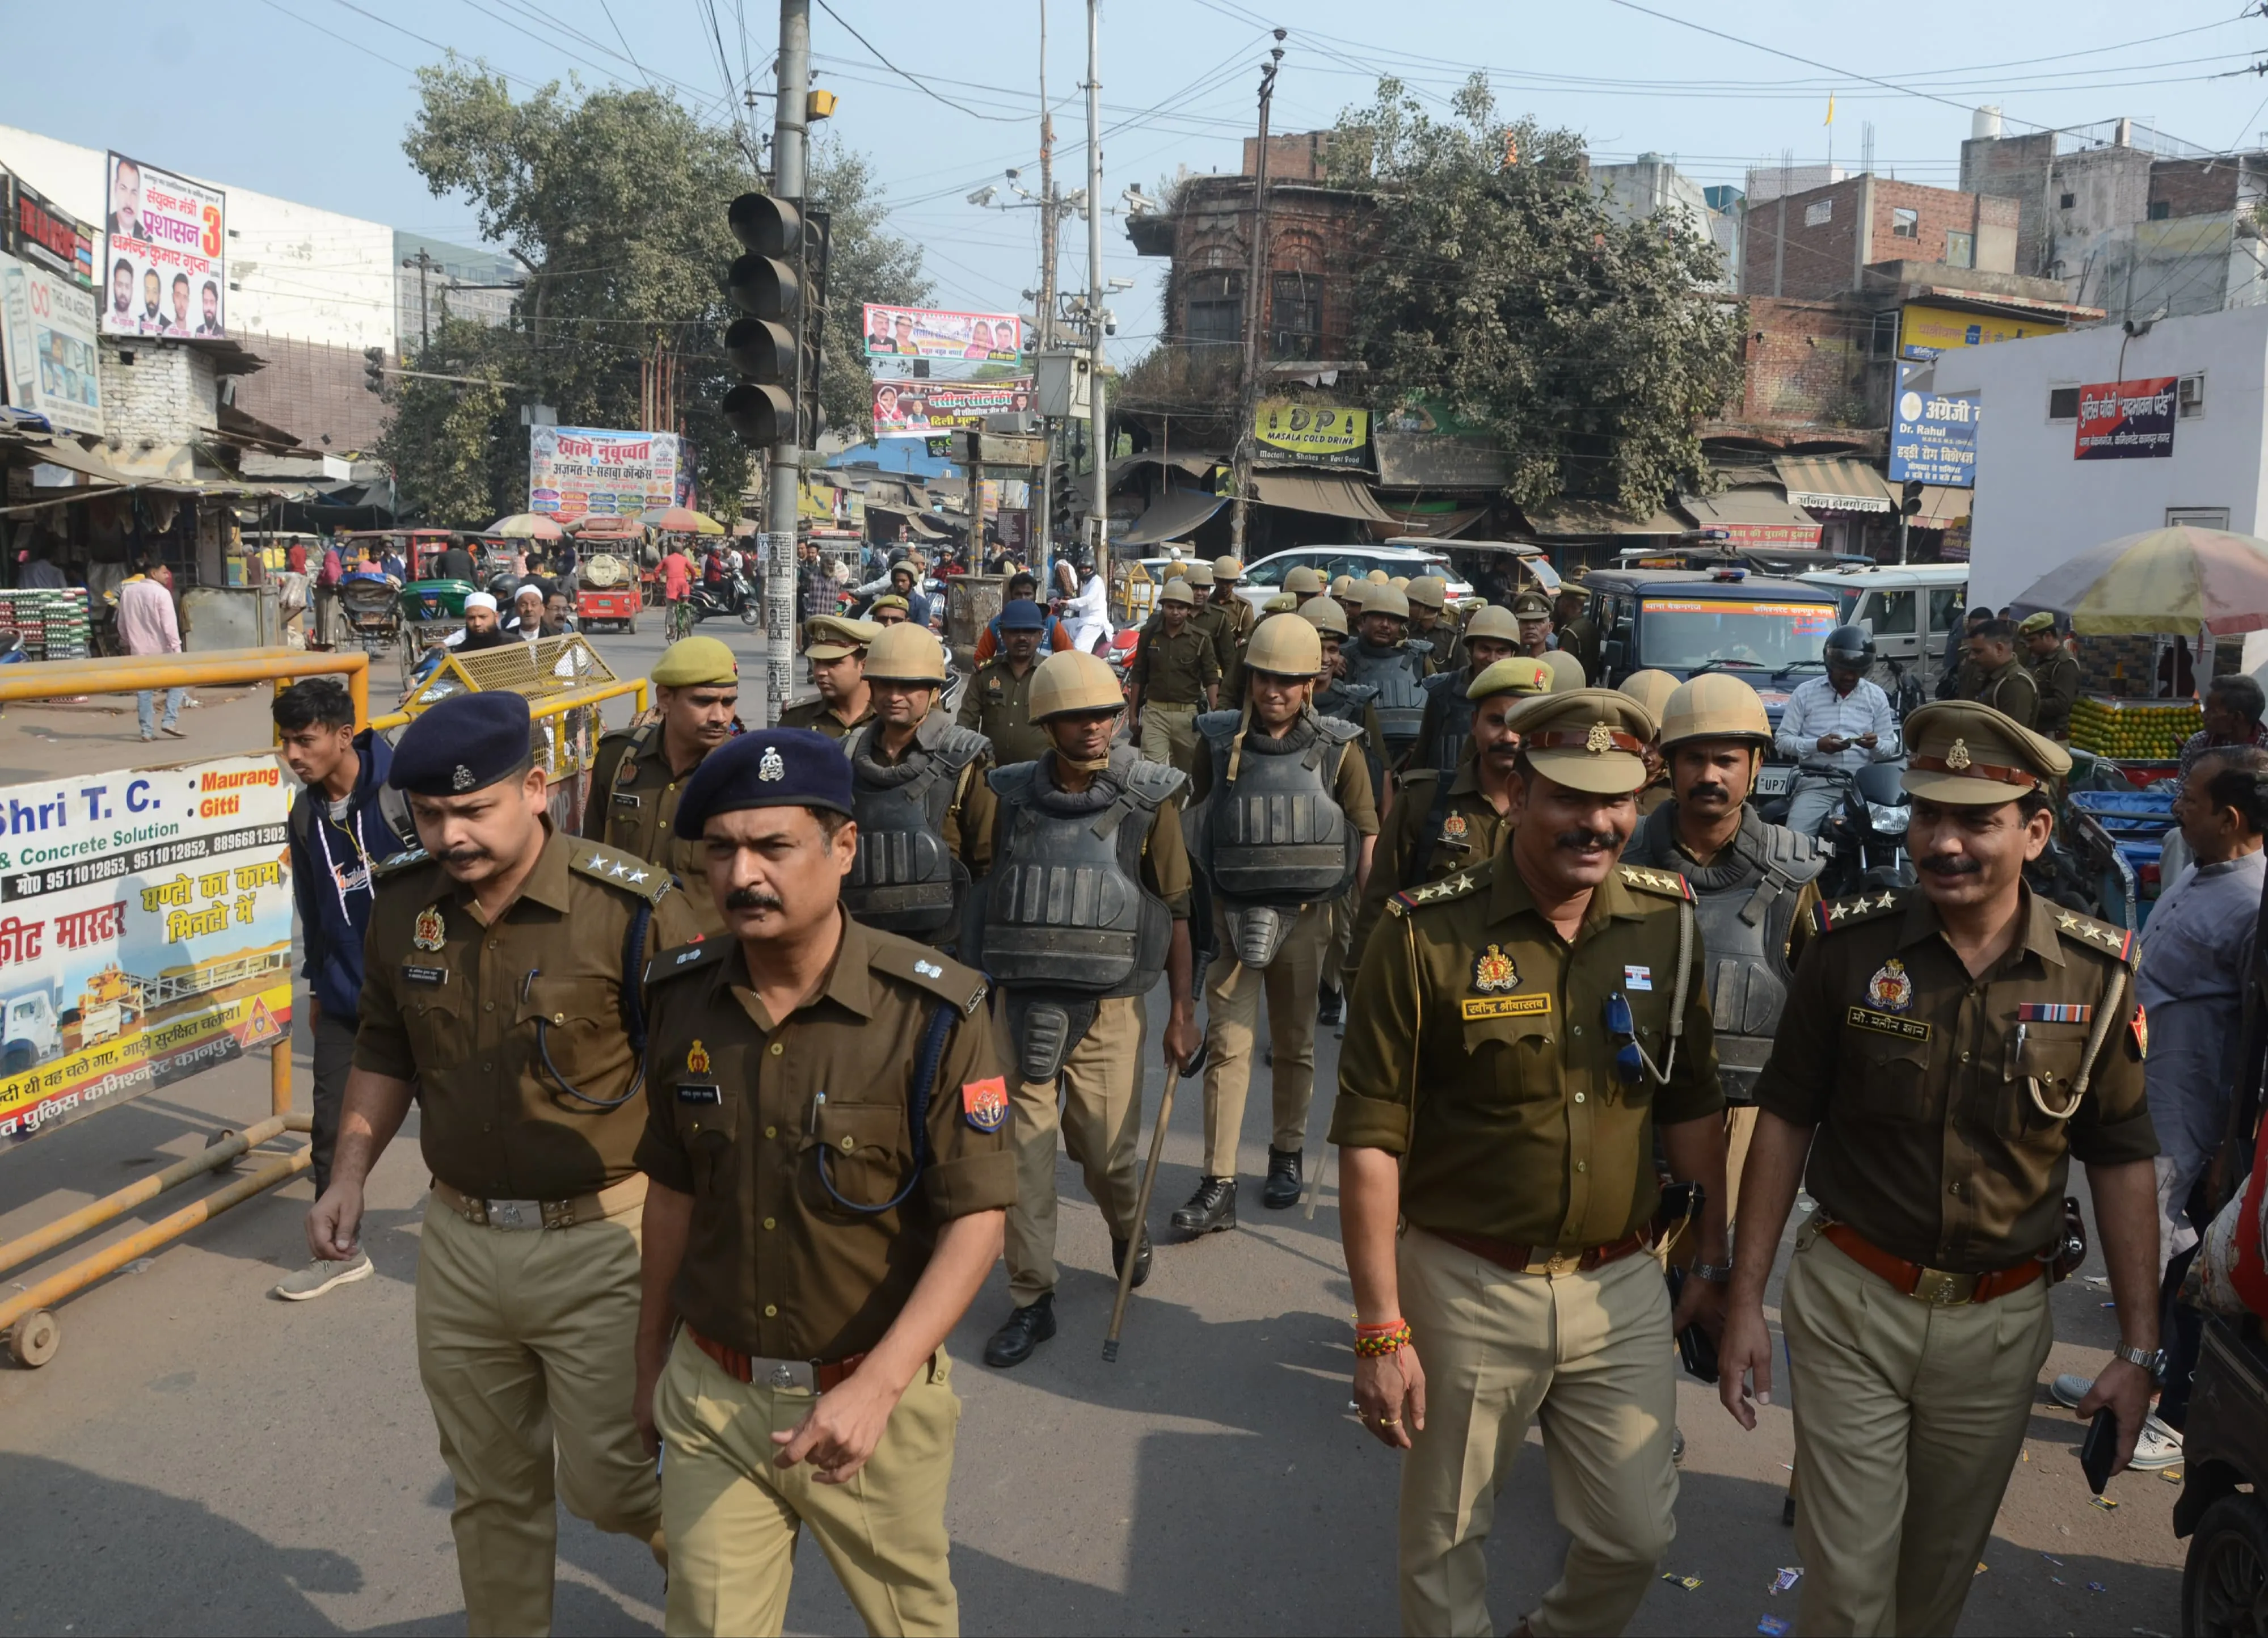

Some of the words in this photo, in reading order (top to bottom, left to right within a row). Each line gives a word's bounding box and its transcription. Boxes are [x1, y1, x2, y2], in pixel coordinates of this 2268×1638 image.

[147, 188, 176, 211] संयुक्त
[179, 195, 197, 217] मंत्री
[143, 209, 200, 247] प्रशासन
[203, 205, 221, 258] 3
[149, 243, 181, 267] कुमार
[184, 253, 209, 276] गुप्ता
[928, 391, 966, 408] नसीम
[968, 390, 1013, 406] सोलंकी
[1926, 397, 1970, 423] अंग्रेजी
[2080, 393, 2099, 428] पुलिस
[2100, 391, 2116, 418] चौकी
[1290, 408, 1335, 433] DP
[1900, 424, 1913, 433] Dr.
[1917, 424, 1946, 437] Rahul
[1267, 432, 1301, 441] MASALA
[1327, 437, 1355, 445] DRINK
[1296, 453, 1318, 461] Shakes
[1921, 445, 1938, 461] रोग
[1750, 528, 1761, 537] की
[1765, 528, 1788, 539] पुरानी
[1791, 530, 1815, 540] दुकान
[1753, 604, 1788, 614] कमिश्नरेट
[1790, 607, 1815, 617] कानपुर
[201, 768, 279, 792] Maurang
[81, 785, 112, 821] T.
[126, 780, 161, 812] C.
[200, 795, 240, 819] Gitti
[20, 836, 107, 866] Concrete
[113, 822, 179, 847] Solution
[47, 857, 129, 890] 9511012853,
[134, 840, 209, 870] 9511012852,
[214, 826, 286, 852] 8896681302
[141, 873, 193, 912] घण्टो
[199, 870, 230, 898] का
[234, 861, 279, 890] काम
[54, 900, 128, 951] मास्टर
[167, 900, 230, 944] मिनटो
[235, 892, 256, 924] में
[1468, 1001, 1497, 1014] रवीन्द्र
[1499, 999, 1544, 1012] श्रीवास्तव
[1852, 1011, 1868, 1024] मो.
[1903, 1022, 1925, 1037] खान
[24, 1076, 41, 1094] थी
[44, 1069, 62, 1087] वह
[66, 1058, 90, 1077] चले
[92, 1051, 119, 1068] गए,
[123, 1035, 151, 1059] गाड़ी
[154, 1024, 199, 1051] सुरक्षित
[23, 1092, 79, 1132] पुलिस
[83, 1058, 172, 1101] कमिश्नरेट
[175, 1033, 236, 1067] कानपुर
